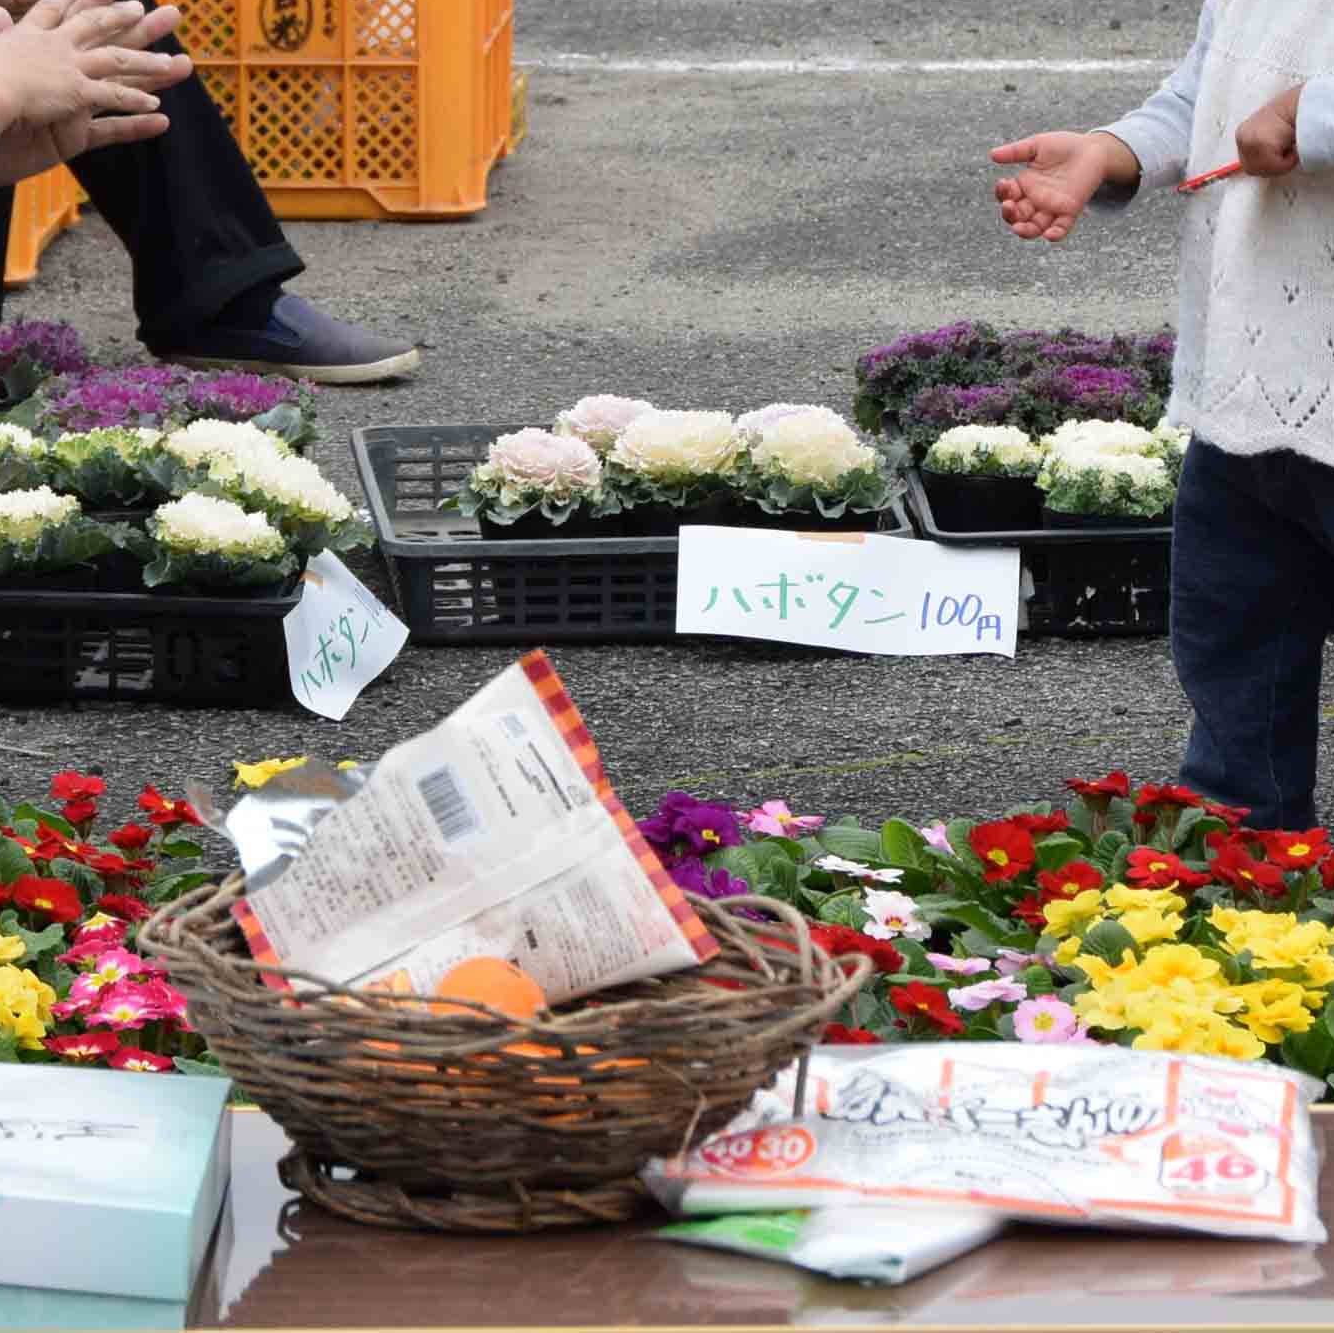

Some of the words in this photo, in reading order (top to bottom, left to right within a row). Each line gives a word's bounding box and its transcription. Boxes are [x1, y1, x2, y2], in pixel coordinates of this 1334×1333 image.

[701, 572, 906, 630] ハボタン
[920, 591, 1003, 641] 100円
[300, 606, 370, 706] ハボタン
